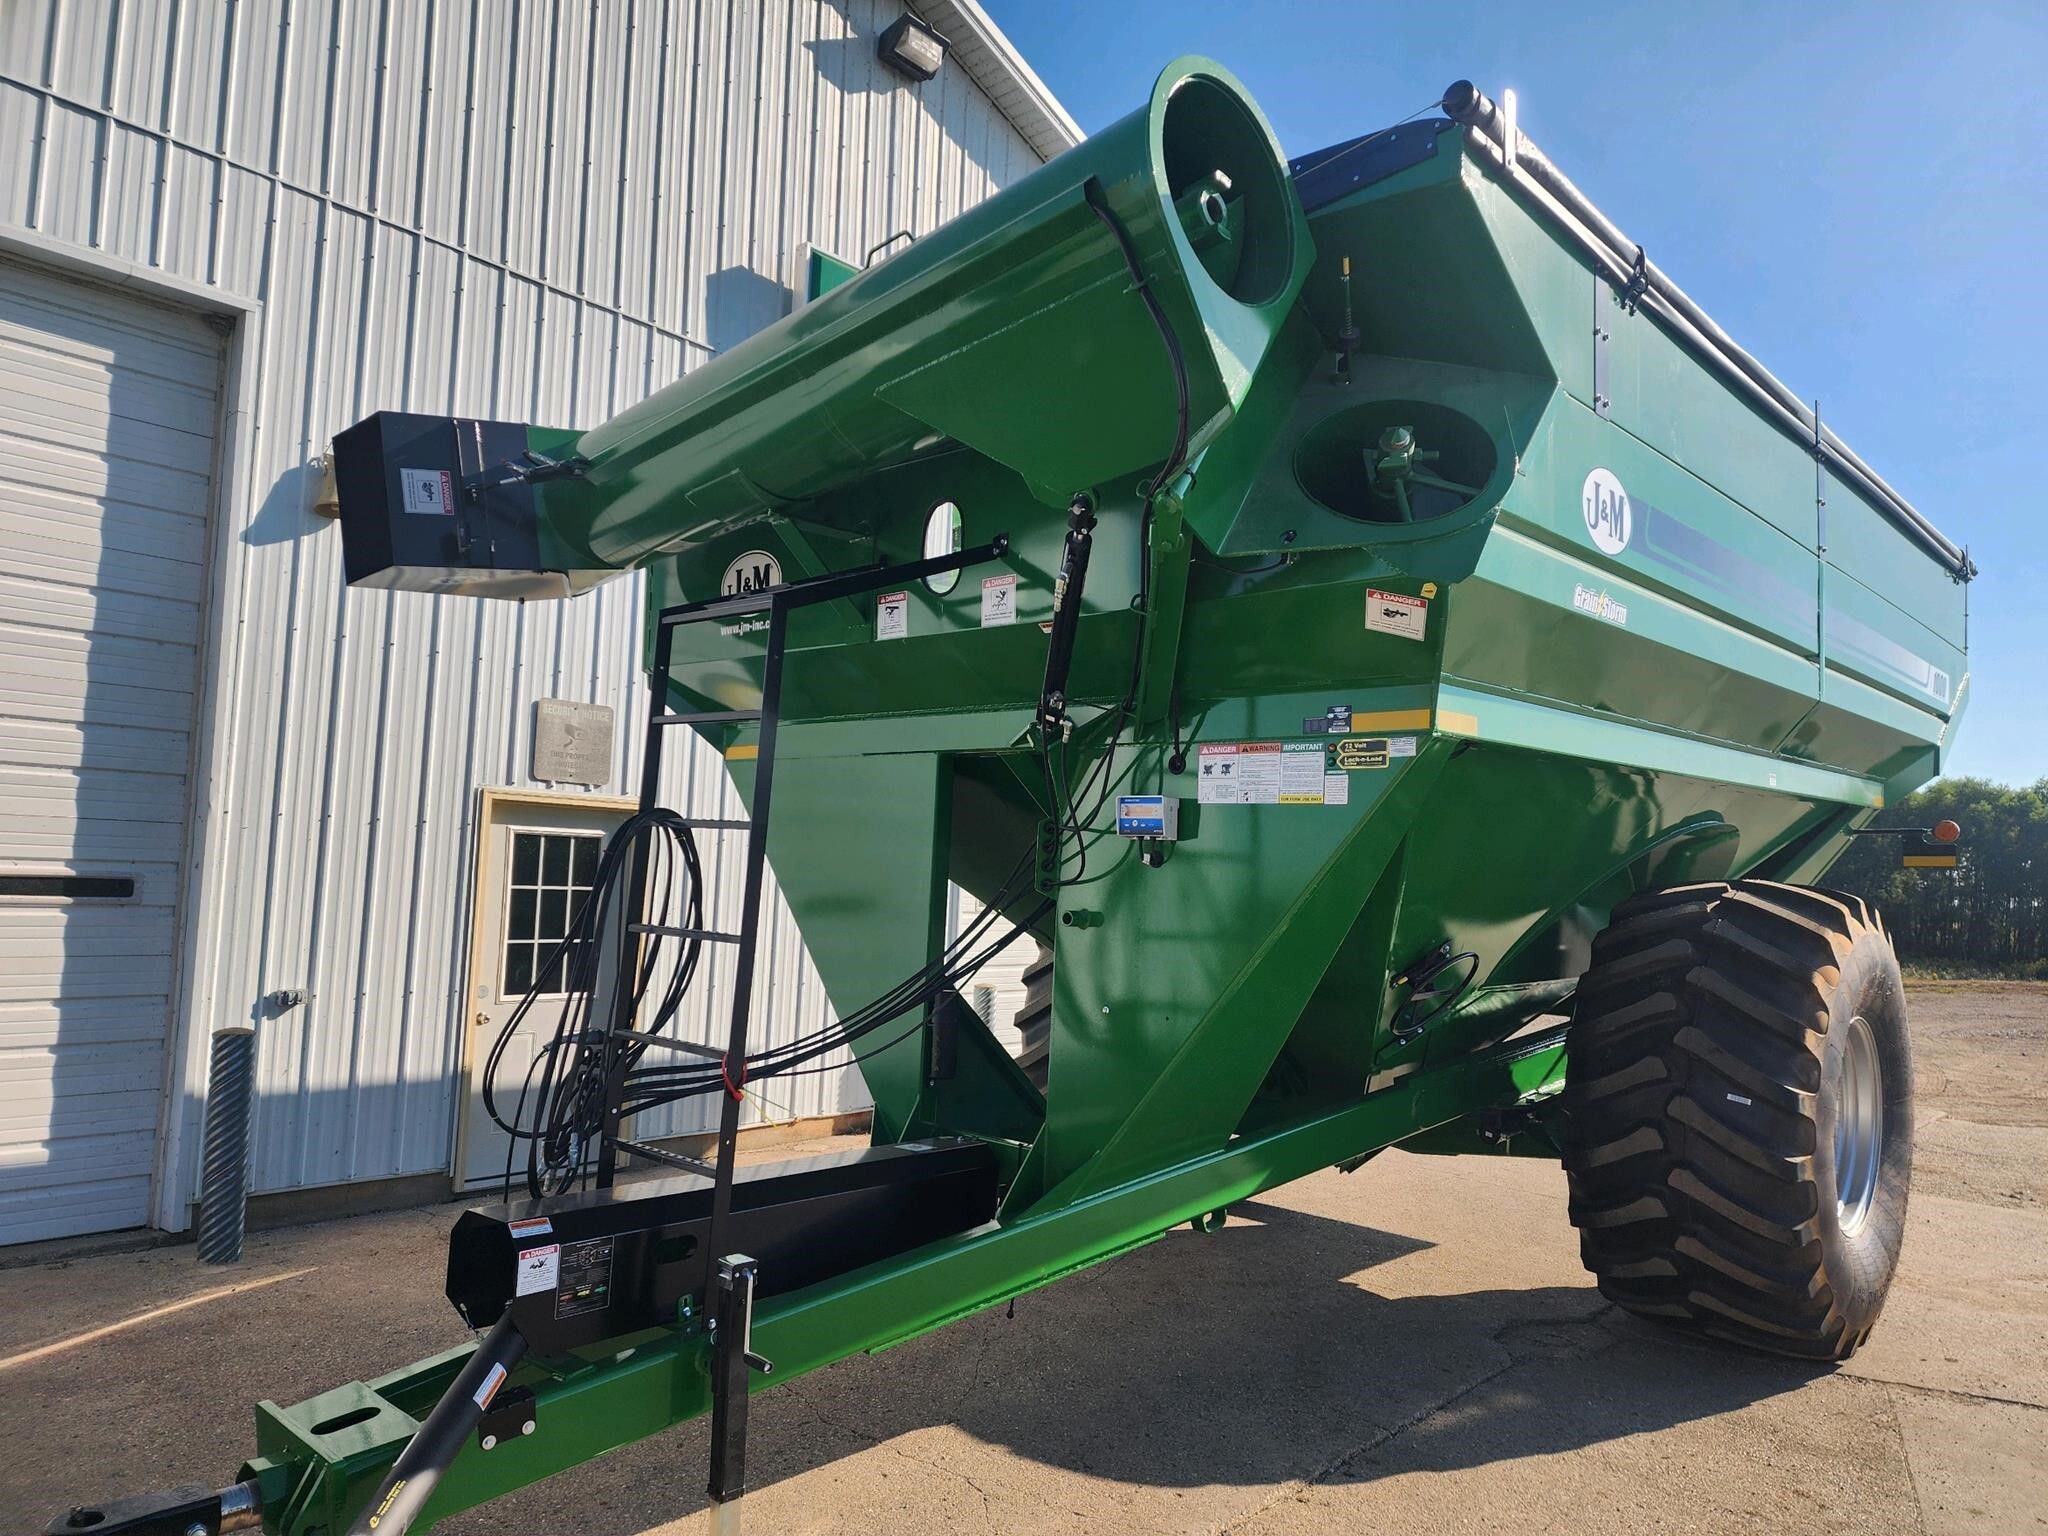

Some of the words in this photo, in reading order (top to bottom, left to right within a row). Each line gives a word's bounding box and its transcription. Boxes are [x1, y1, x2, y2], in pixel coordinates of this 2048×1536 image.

[442, 482, 452, 511] DANGER
[1586, 480, 1624, 543] J&M
[990, 577, 1013, 588] DANGER
[885, 593, 905, 602] DANGER
[1383, 593, 1421, 606] DANGER
[720, 620, 770, 636] www.jm-inc.c
[1283, 743, 1323, 751] IMPORTANT
[531, 1246, 555, 1258] DANGER
